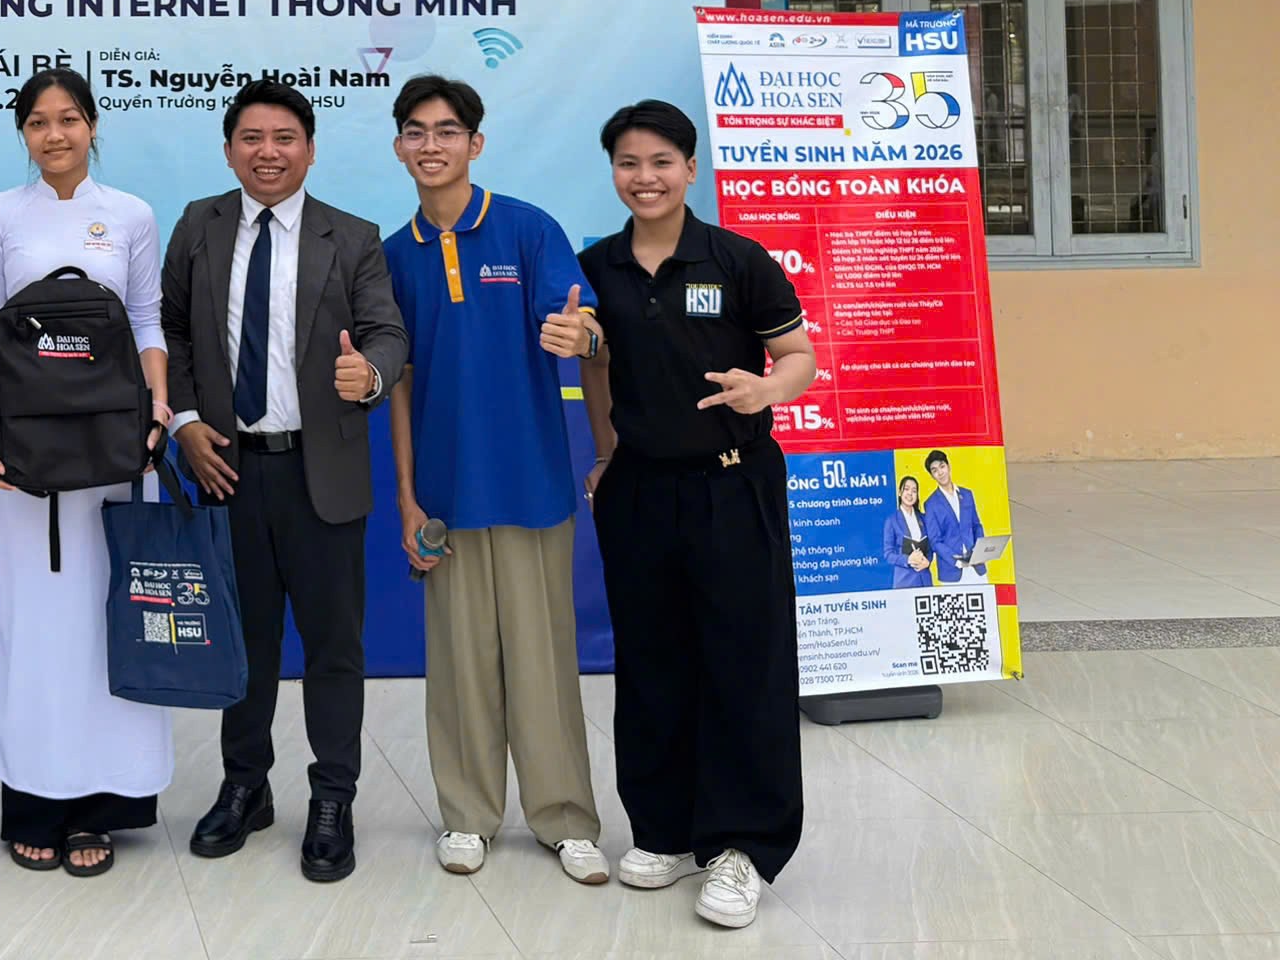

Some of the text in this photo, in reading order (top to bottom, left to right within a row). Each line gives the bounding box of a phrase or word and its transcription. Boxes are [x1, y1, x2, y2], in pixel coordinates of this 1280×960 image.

[705, 12, 831, 23] www.hoasen.edu.vn
[905, 31, 959, 51] HSU
[99, 48, 160, 61] DIỄN GIẢ:
[31, 49, 73, 75] BÈ
[101, 64, 390, 91] TS. Nguyễn Hoài Nam
[759, 71, 841, 89] ĐẠI HỌC
[157, 95, 216, 111] Trưởng
[761, 92, 843, 108] HOA SEN
[860, 72, 961, 130] 35
[723, 116, 836, 127] TÔN TRỌNG SỰ KHÁC BIỆT
[718, 139, 963, 162] TUYỂN SINH NĂM 2026
[721, 174, 966, 200] HỌC BỔNG TOÀN KHÓA
[790, 404, 835, 430] 15%
[786, 474, 820, 490] ỔNG
[849, 473, 879, 488] NĂM
[881, 474, 887, 487] 1
[796, 496, 883, 509] chương trình đào tạo
[793, 517, 840, 527] kinh doanh
[808, 544, 845, 555] thông tin
[819, 559, 830, 569] đa
[831, 558, 861, 570] phương
[798, 574, 823, 583] khách
[799, 602, 822, 615] TÂM
[861, 600, 887, 611] SINH
[177, 626, 202, 638] HSU
[799, 639, 857, 650] com/HoaSenUni
[799, 648, 880, 661] ensinh.hoasen.edu.vn/
[833, 662, 847, 671] 620
